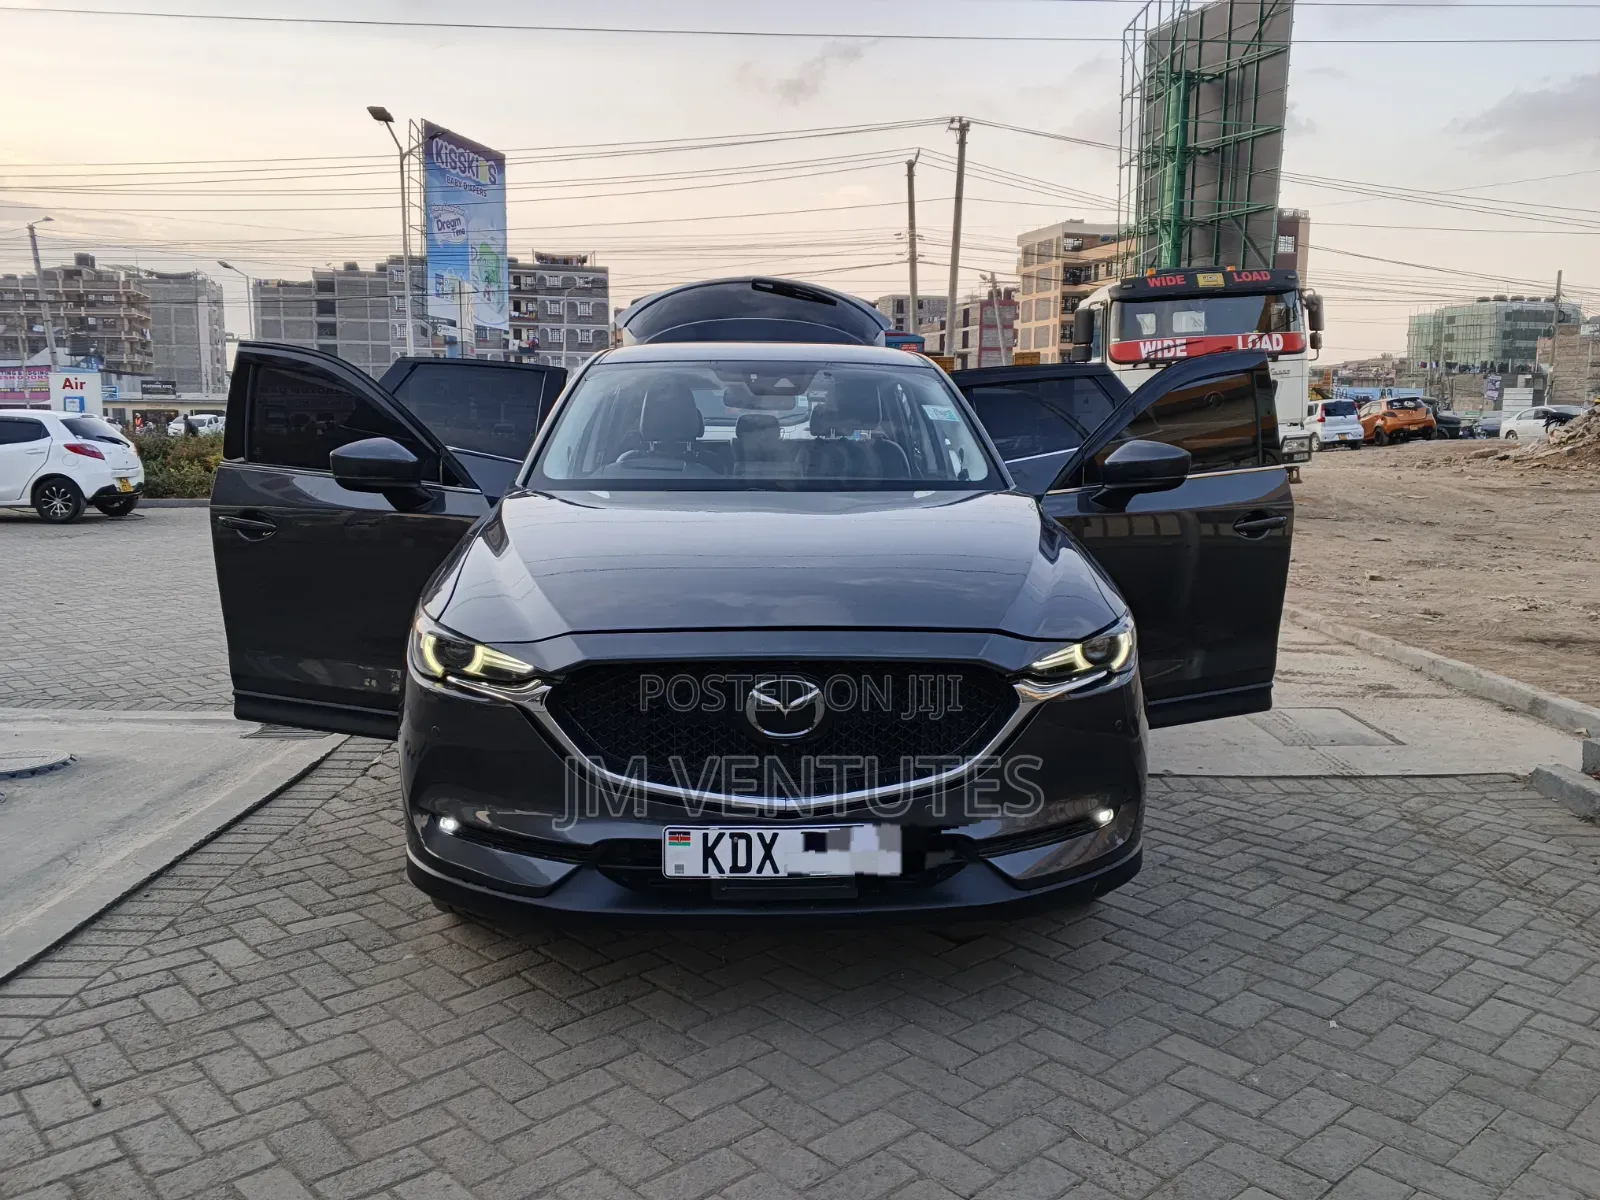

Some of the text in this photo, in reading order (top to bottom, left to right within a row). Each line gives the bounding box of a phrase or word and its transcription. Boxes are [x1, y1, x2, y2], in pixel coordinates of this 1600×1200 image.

[446, 175, 462, 188] BABY
[436, 217, 462, 231] Dream
[1146, 270, 1272, 288] WIDE LOAD
[1139, 333, 1284, 359] WIDE LOAD
[62, 377, 86, 390] Air
[701, 831, 780, 875] KDX
